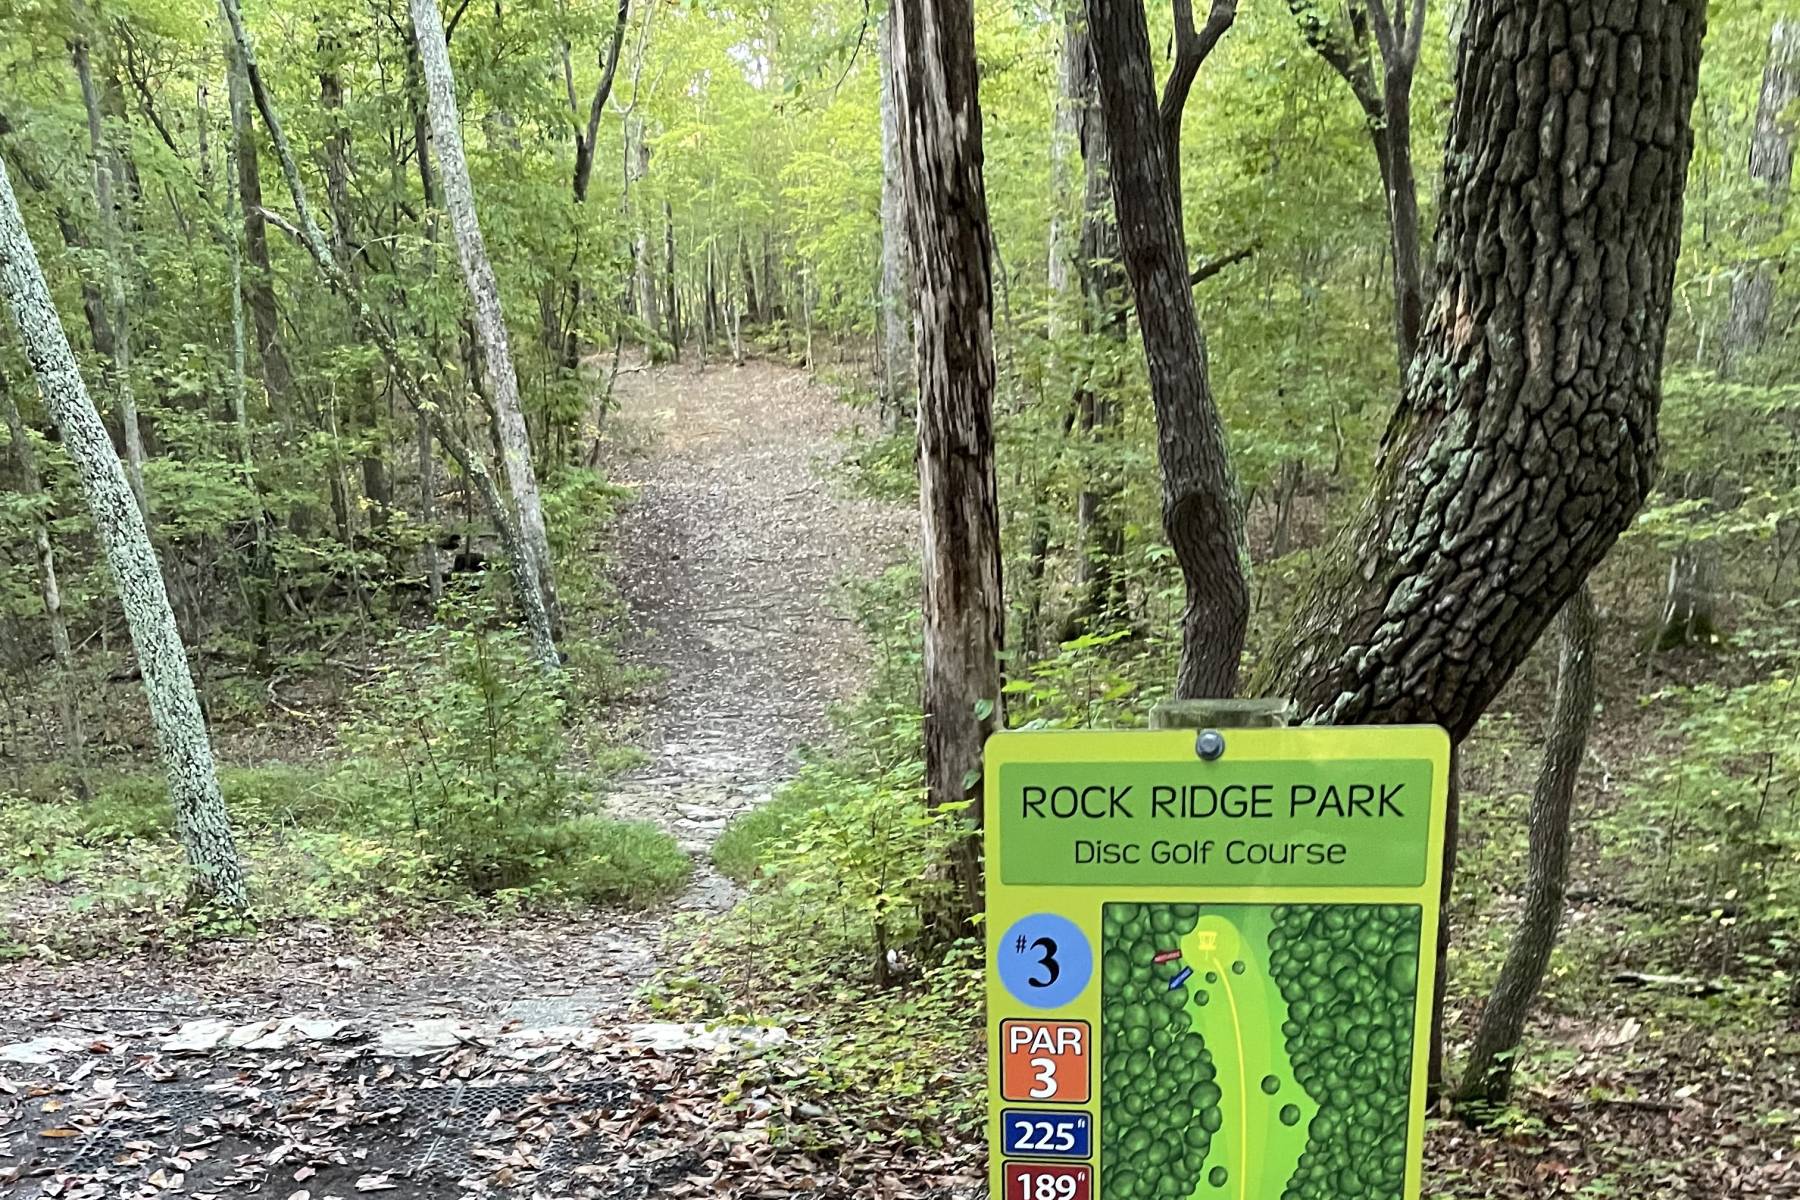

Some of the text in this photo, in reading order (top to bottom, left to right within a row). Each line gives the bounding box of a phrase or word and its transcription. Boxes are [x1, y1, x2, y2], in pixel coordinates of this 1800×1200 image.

[1022, 784, 1405, 819] ROCK RIDGE PARK
[1075, 840, 1347, 864] Disc Golf Course
[1009, 1025, 1083, 1055] PAR
[1029, 1057, 1058, 1099] 3
